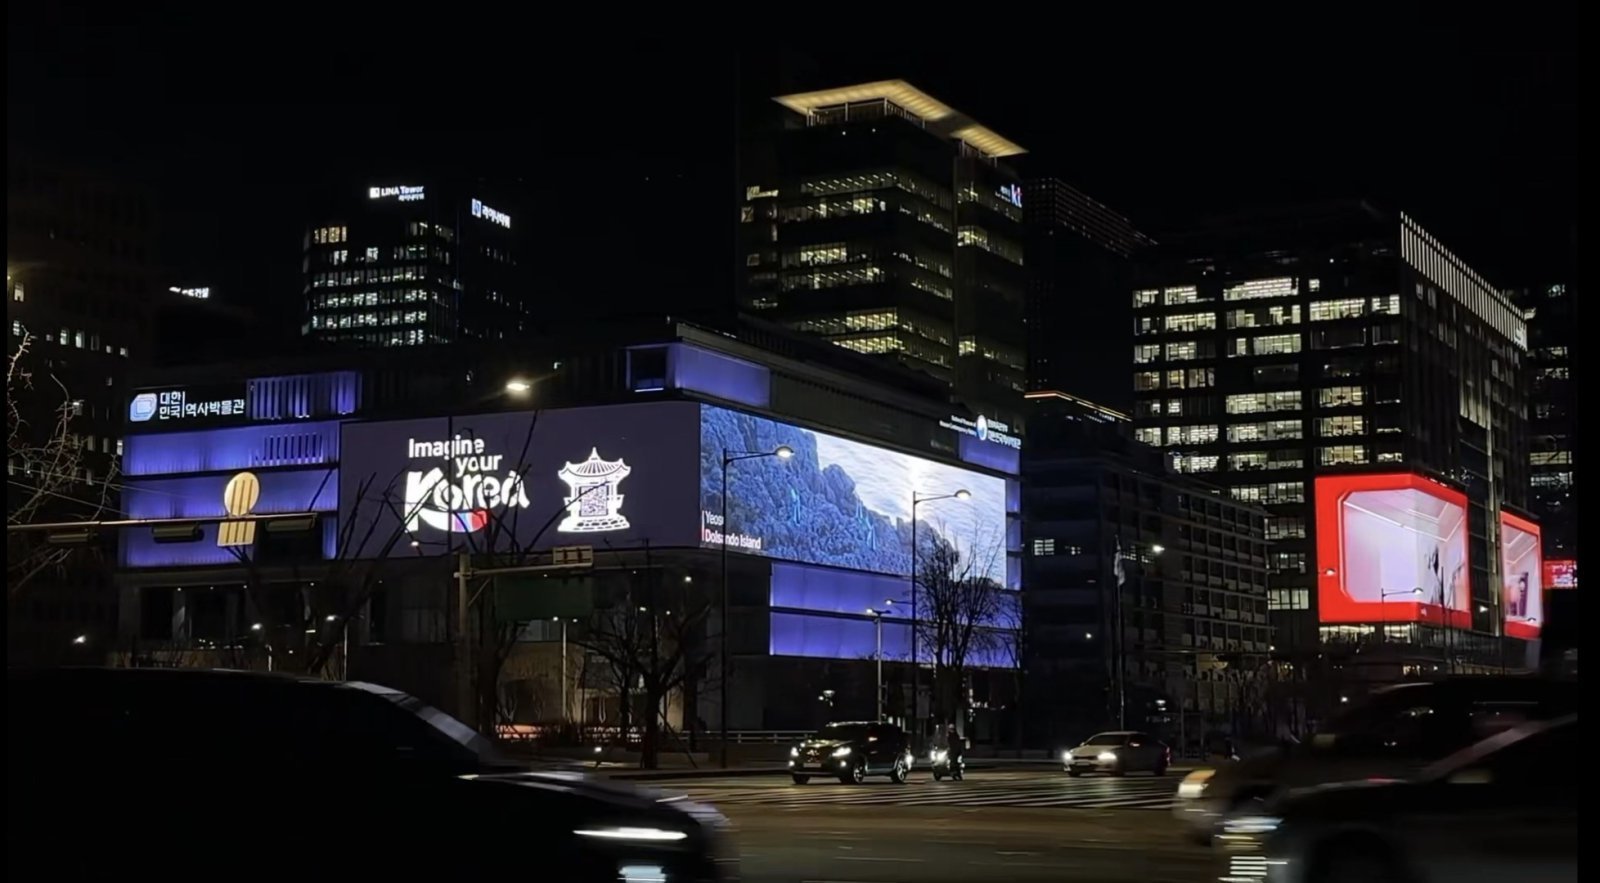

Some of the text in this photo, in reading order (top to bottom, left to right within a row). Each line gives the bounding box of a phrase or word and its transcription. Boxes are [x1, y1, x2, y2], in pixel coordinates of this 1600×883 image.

[381, 185, 424, 196] LINA Tower
[1011, 184, 1022, 208] kt
[160, 391, 181, 405] 대한
[159, 406, 181, 420] 민국
[186, 399, 245, 417] 역사박물관
[408, 435, 485, 460] Imagine
[455, 454, 502, 478] your
[404, 467, 530, 533] Korea
[705, 511, 724, 526] Yeos
[740, 534, 761, 550] Island
